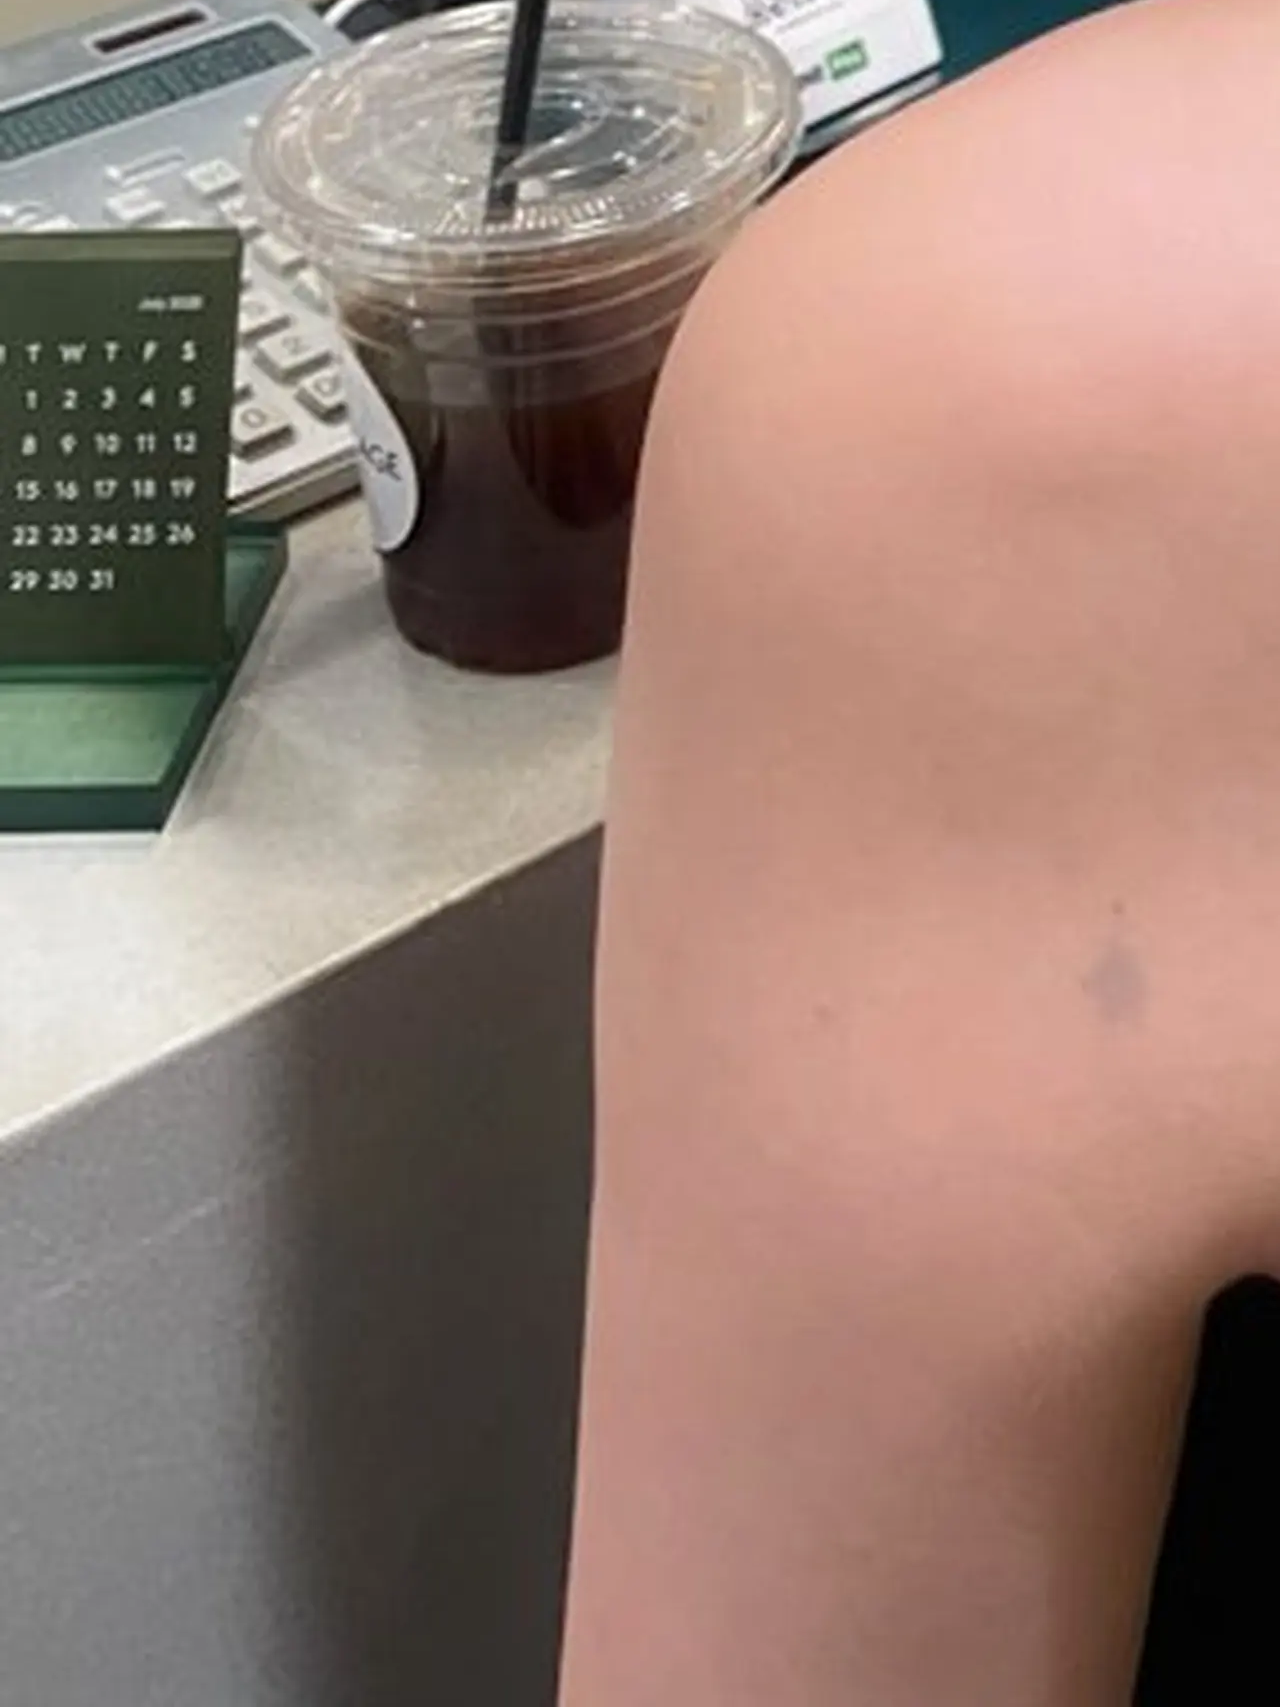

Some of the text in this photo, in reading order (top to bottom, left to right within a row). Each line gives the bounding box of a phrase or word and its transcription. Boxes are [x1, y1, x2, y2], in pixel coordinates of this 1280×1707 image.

[59, 343, 86, 363] W
[181, 340, 196, 362] S
[26, 389, 38, 409] 1
[63, 388, 78, 410] 2
[101, 386, 116, 410] 3
[139, 388, 155, 407] 4
[60, 434, 77, 454] 9
[95, 433, 120, 454] 10
[135, 433, 157, 453] 11
[173, 432, 197, 453] 12
[15, 477, 196, 501] 15 16 17 18 19
[12, 523, 195, 546] 22 23 24 25 26
[10, 569, 114, 591] 29 30 31
